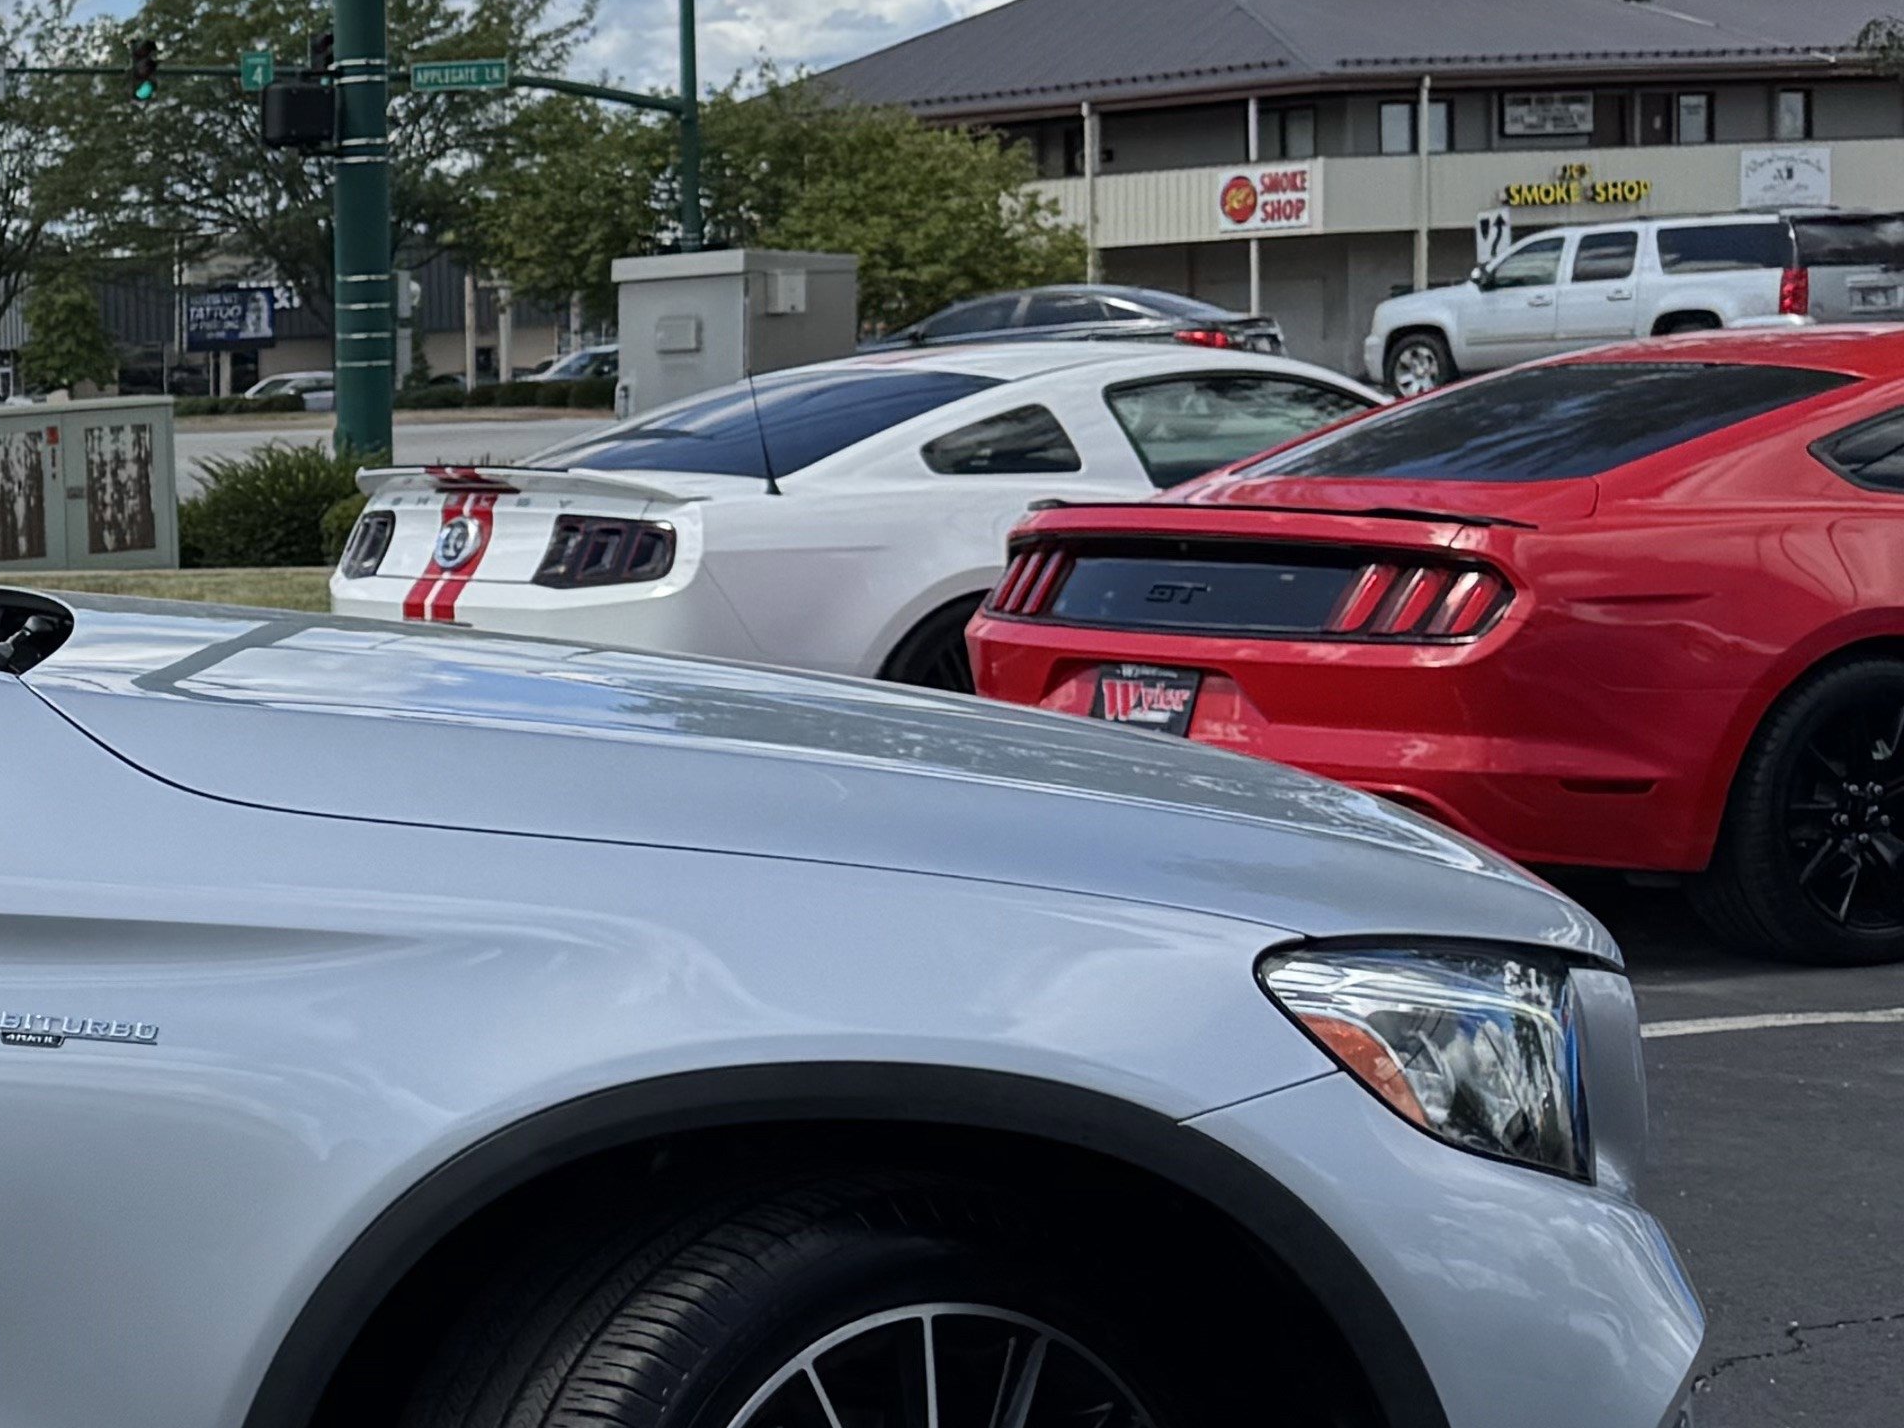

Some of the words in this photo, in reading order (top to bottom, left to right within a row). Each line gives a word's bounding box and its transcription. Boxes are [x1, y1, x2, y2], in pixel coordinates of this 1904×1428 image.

[1260, 170, 1307, 195] SMOKE
[1507, 180, 1581, 206] SMOKE
[1594, 180, 1652, 204] SHOP
[1260, 198, 1306, 223] SHOP
[190, 304, 242, 320] TATTOO
